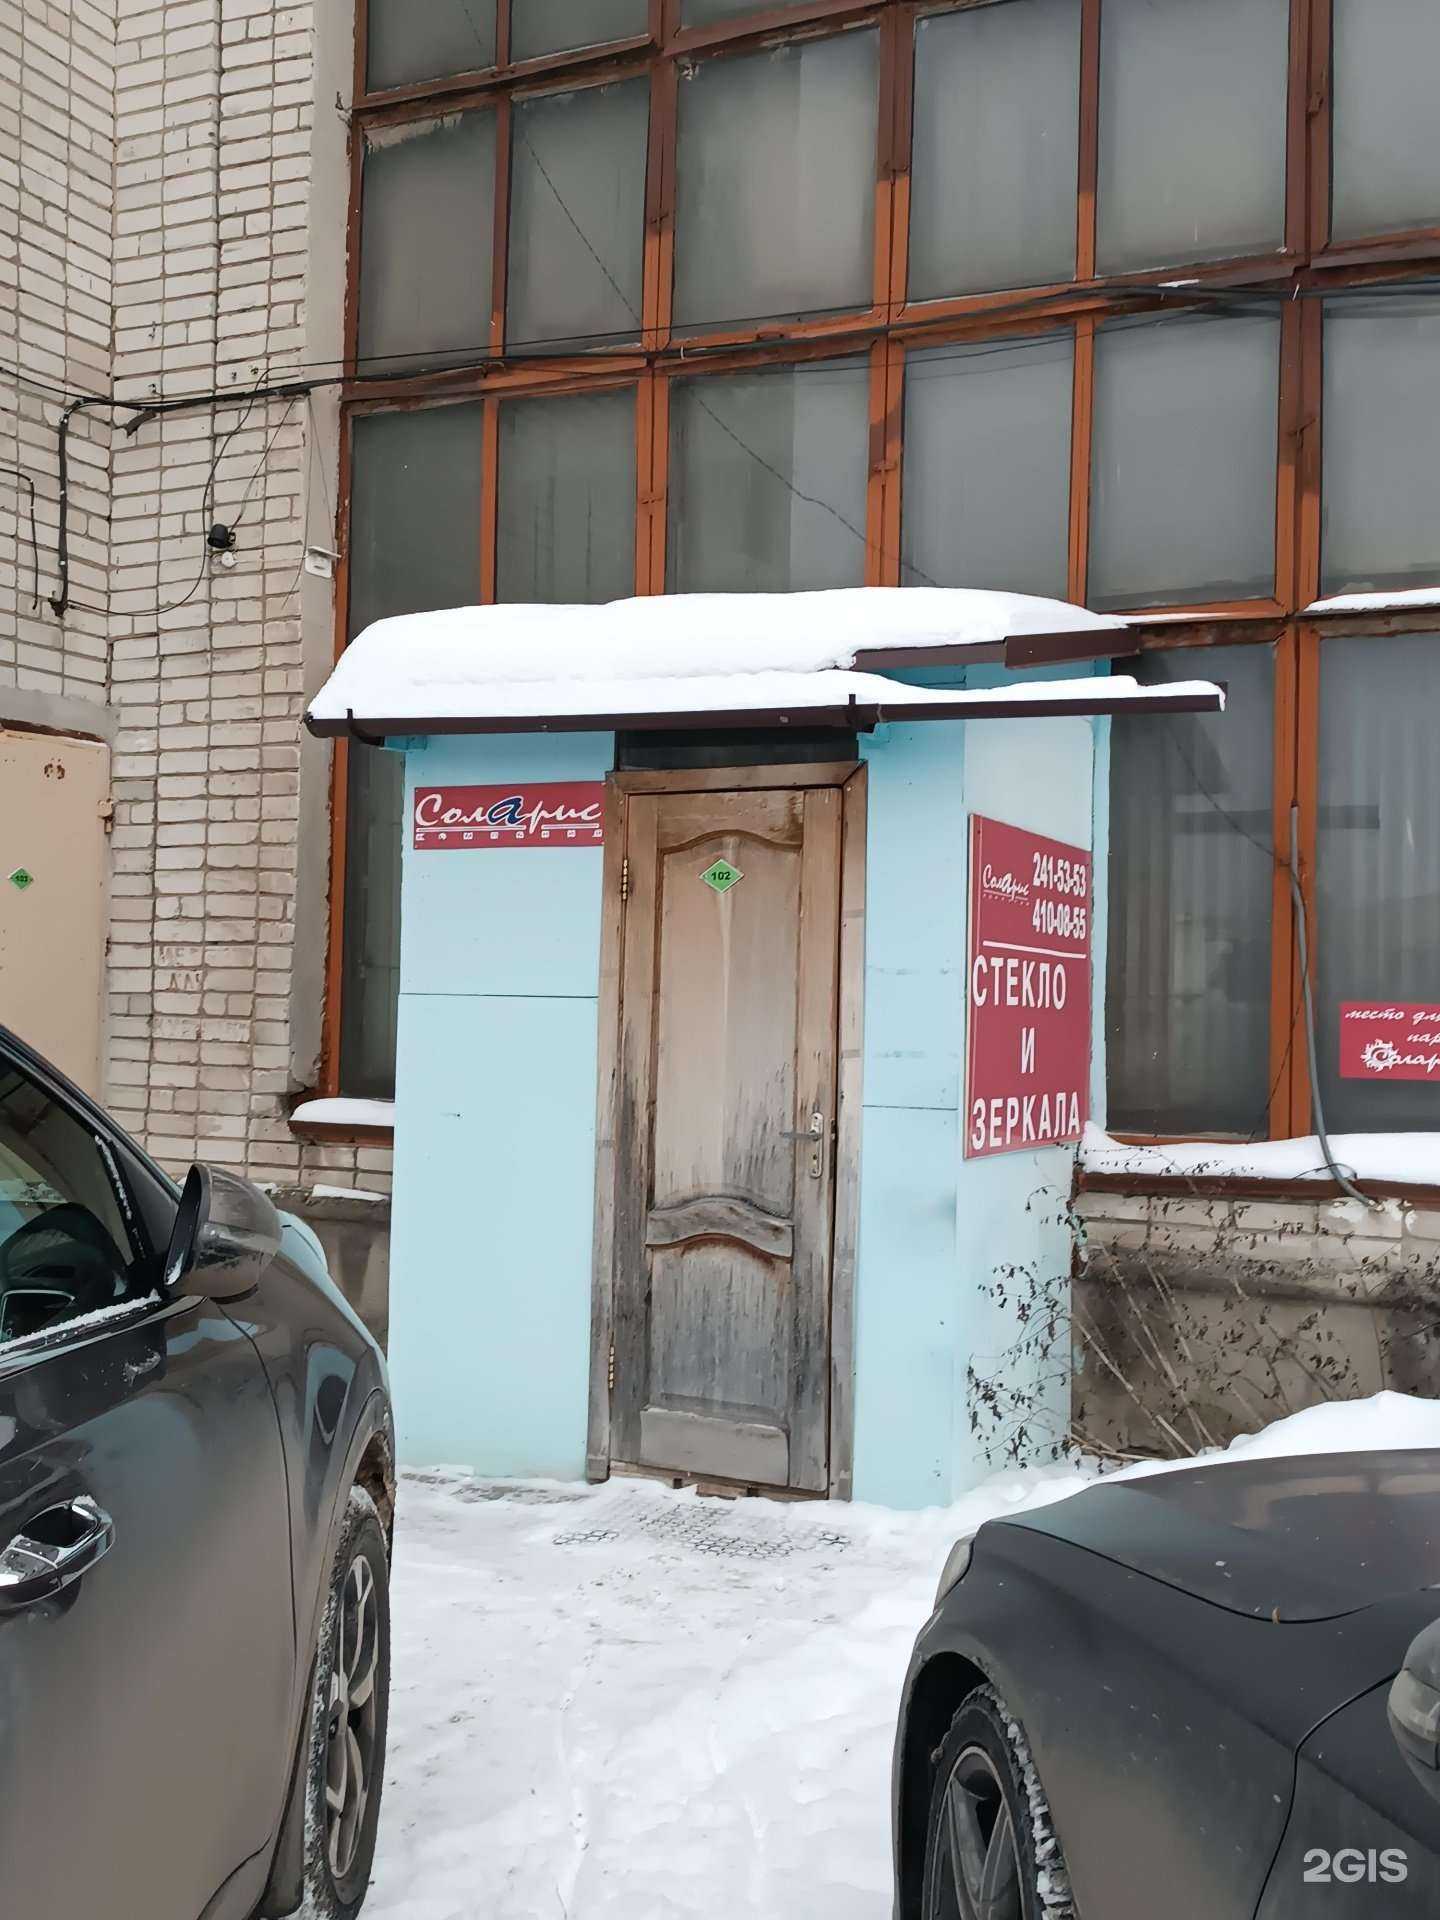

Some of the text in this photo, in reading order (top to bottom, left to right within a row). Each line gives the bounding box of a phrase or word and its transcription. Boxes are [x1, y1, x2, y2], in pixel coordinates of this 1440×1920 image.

[415, 794, 601, 834] Соларис
[711, 871, 731, 881] 102
[1033, 852, 1086, 897] 241-53-53
[1032, 898, 1086, 939] 410-08-55
[972, 955, 1066, 1010] СТЕКЛО
[1345, 1008, 1405, 1020] место
[1021, 1027, 1035, 1073] И
[972, 1092, 1080, 1150] ЗЕРКАЛА
